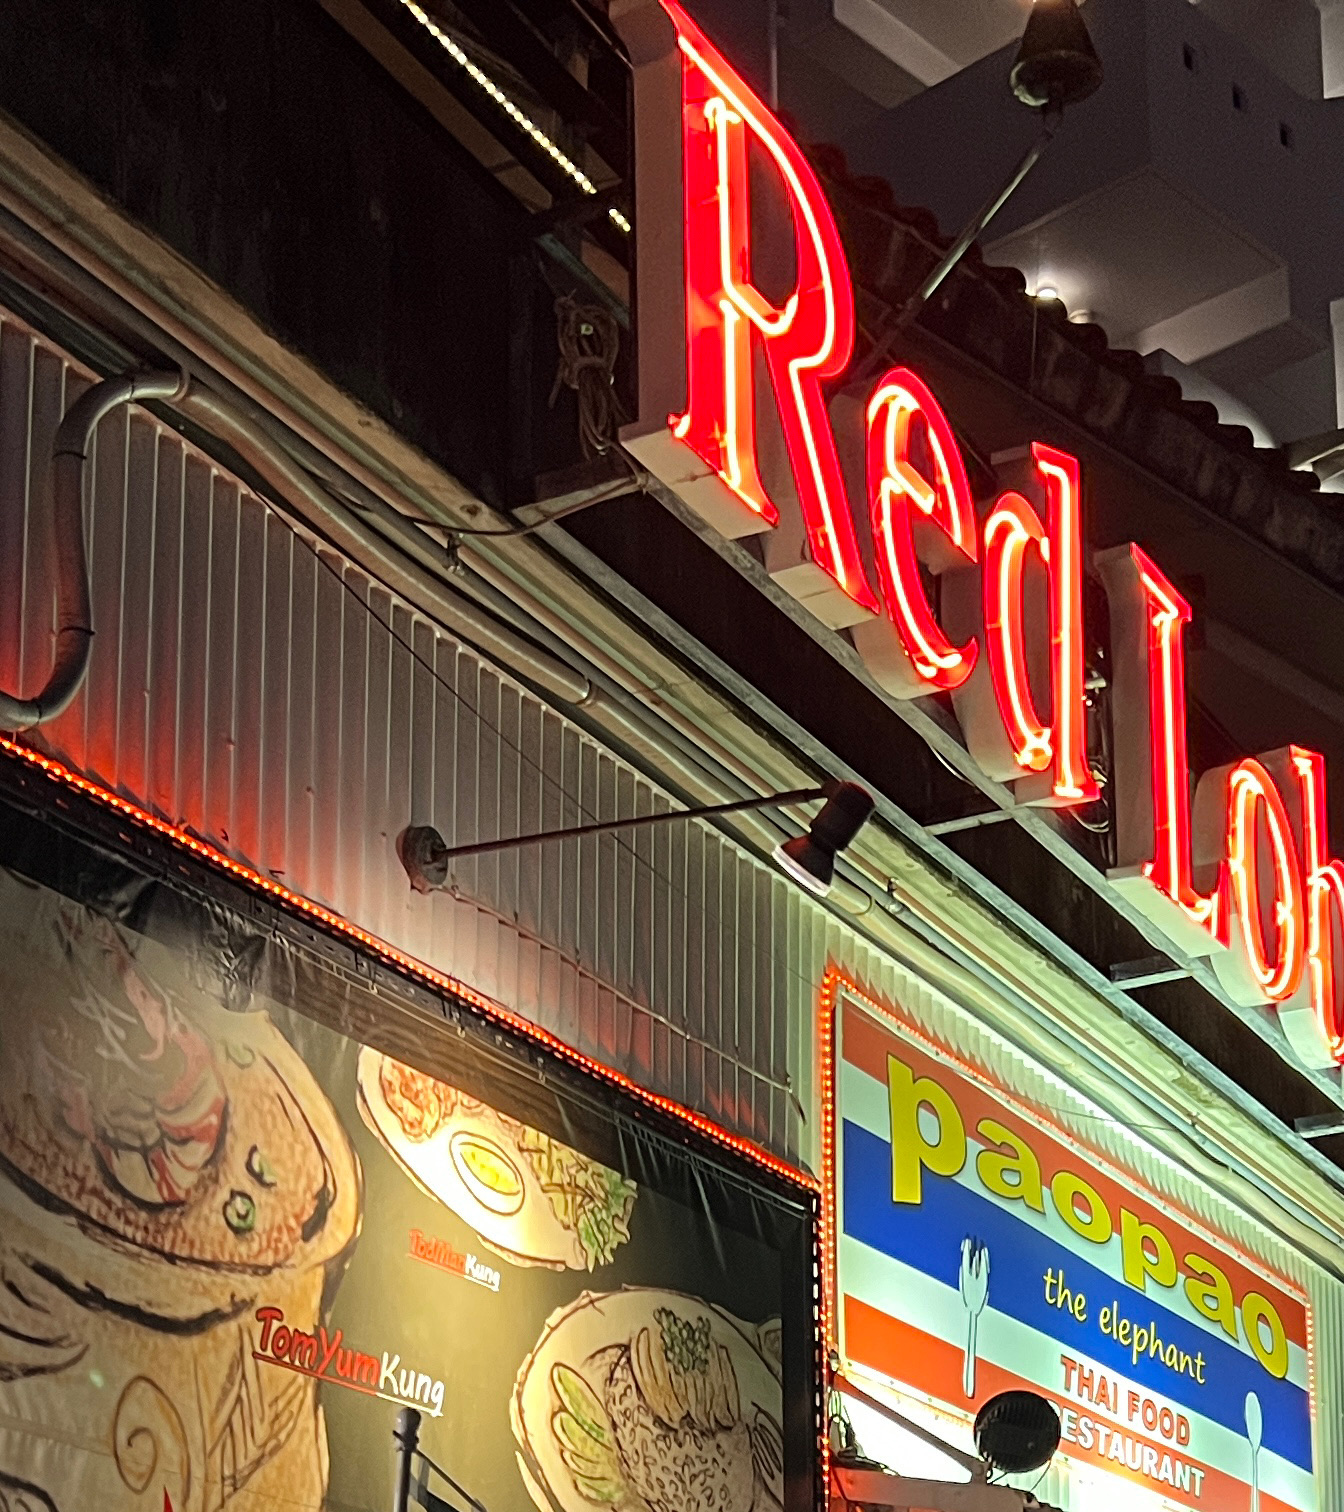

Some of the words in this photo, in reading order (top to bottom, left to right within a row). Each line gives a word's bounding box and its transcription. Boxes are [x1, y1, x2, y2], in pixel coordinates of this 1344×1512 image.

[660, 0, 1101, 803] Red
[886, 1052, 1289, 1379] paopao
[1043, 1266, 1087, 1323] the
[1099, 1299, 1207, 1385] elephant
[1056, 1402, 1205, 1498] ESTAURANT
[1060, 1353, 1118, 1415] THAI
[1127, 1389, 1191, 1446] FOOD
